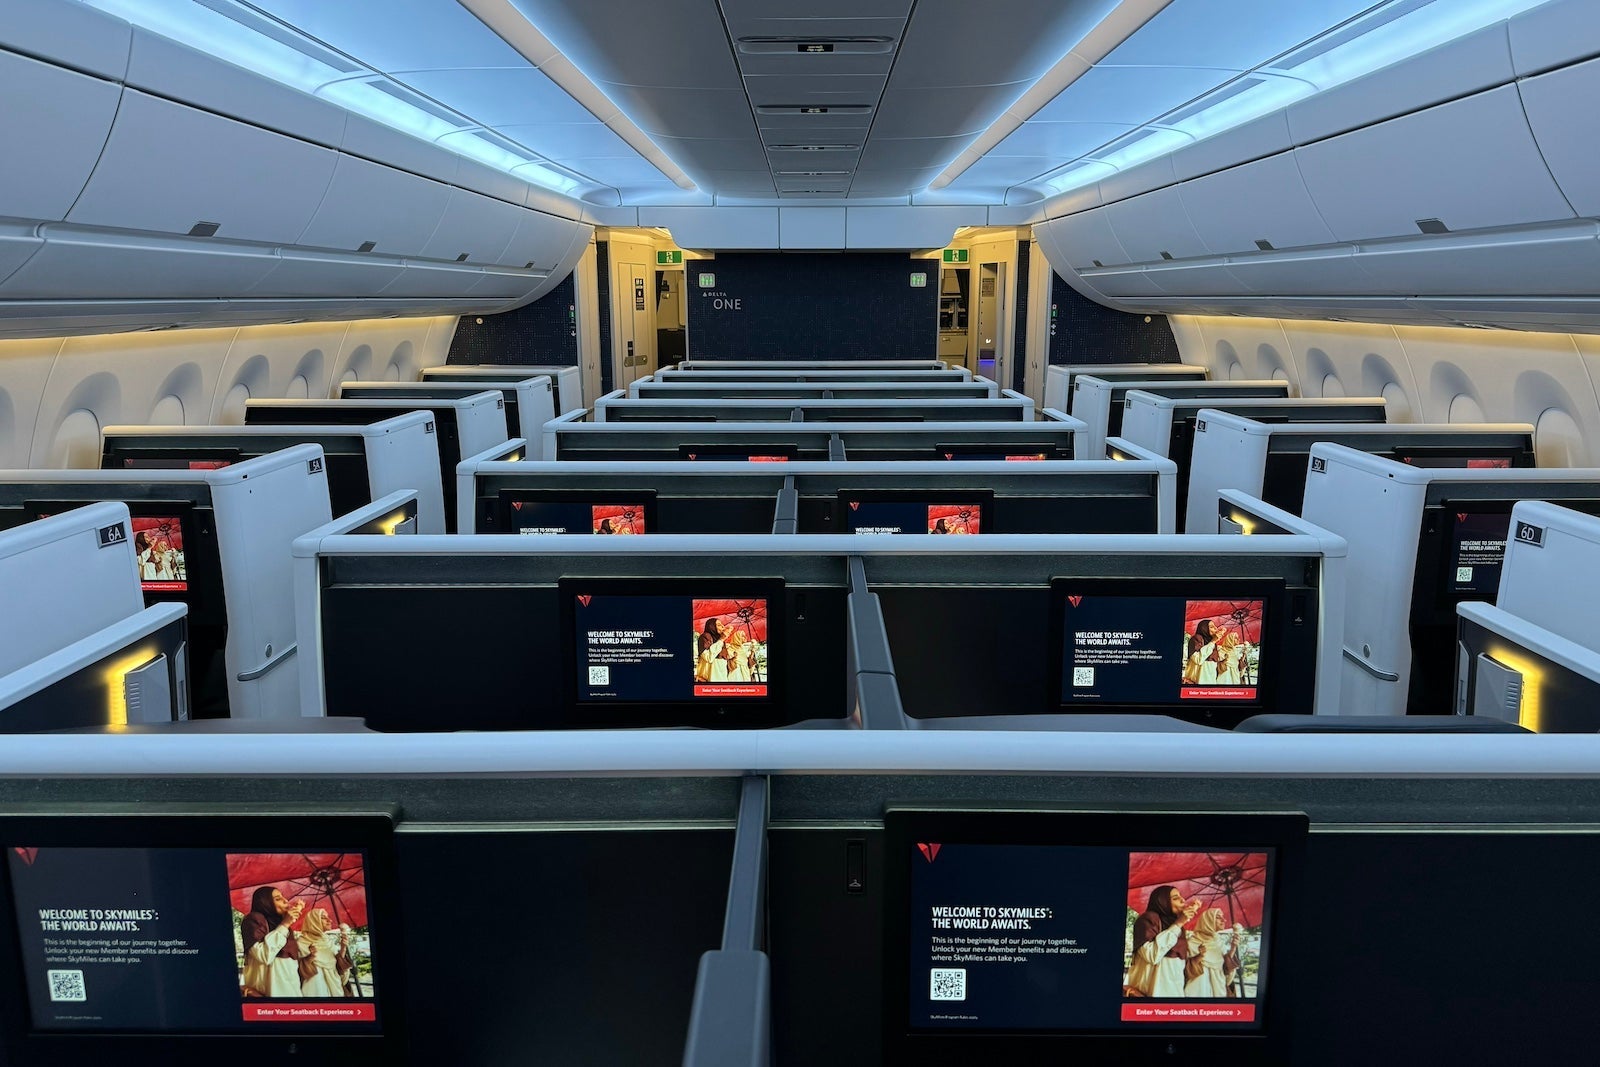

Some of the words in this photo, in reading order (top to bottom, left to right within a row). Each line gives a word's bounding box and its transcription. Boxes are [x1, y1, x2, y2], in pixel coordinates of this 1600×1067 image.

[714, 299, 742, 310] ONE
[108, 526, 122, 541] 6A
[1521, 526, 1535, 540] 6D
[39, 909, 88, 920] WELCOME
[90, 909, 103, 920] TO
[932, 907, 981, 918] WELCOME
[983, 907, 996, 918] TO
[40, 921, 60, 931] THE
[61, 921, 98, 931] WORLD
[100, 921, 140, 931] AWAITS.
[932, 918, 951, 929] THE
[953, 918, 989, 929] WORLD
[991, 919, 1031, 929] AWAITS.
